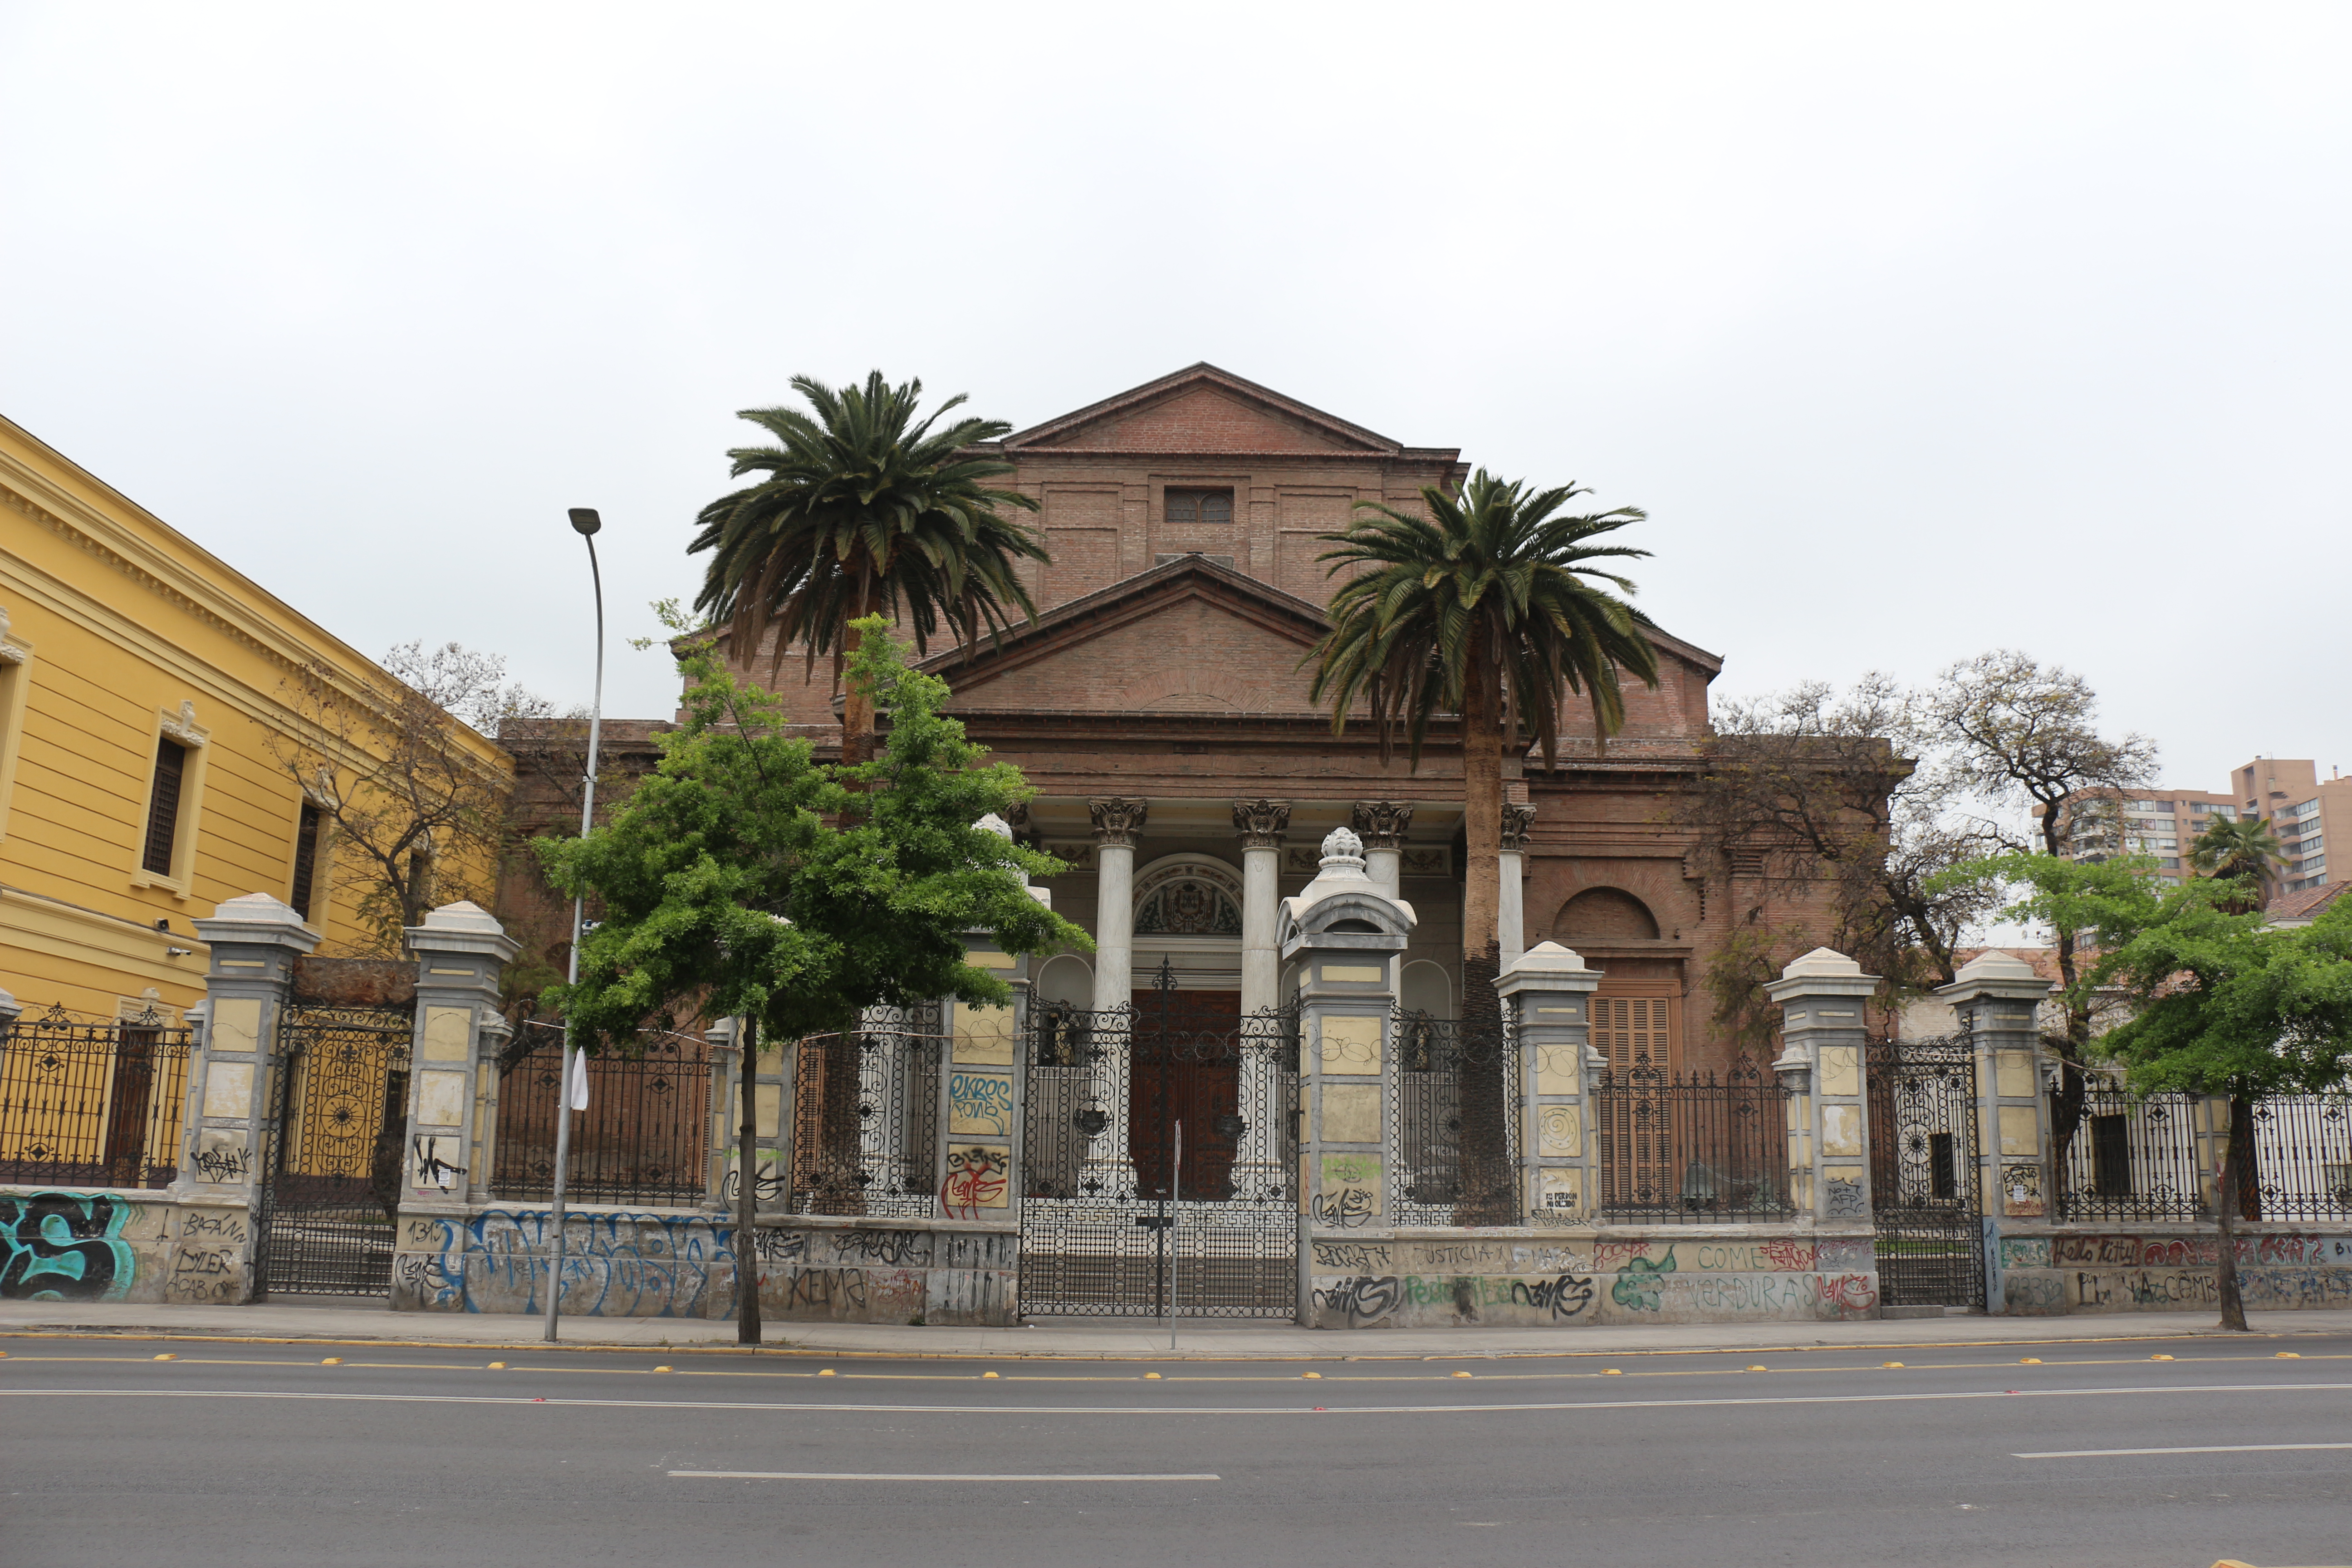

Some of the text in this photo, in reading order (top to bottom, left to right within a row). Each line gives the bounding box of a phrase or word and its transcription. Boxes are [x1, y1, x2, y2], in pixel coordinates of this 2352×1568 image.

[1554, 1190, 1577, 1200] PERDÓN
[1830, 1194, 1857, 1207] AFP
[1414, 1245, 1493, 1264] JUSTICIA
[1698, 1246, 1764, 1270] COME
[2054, 1236, 2093, 1264] Hello
[164, 1273, 208, 1300] ACAB
